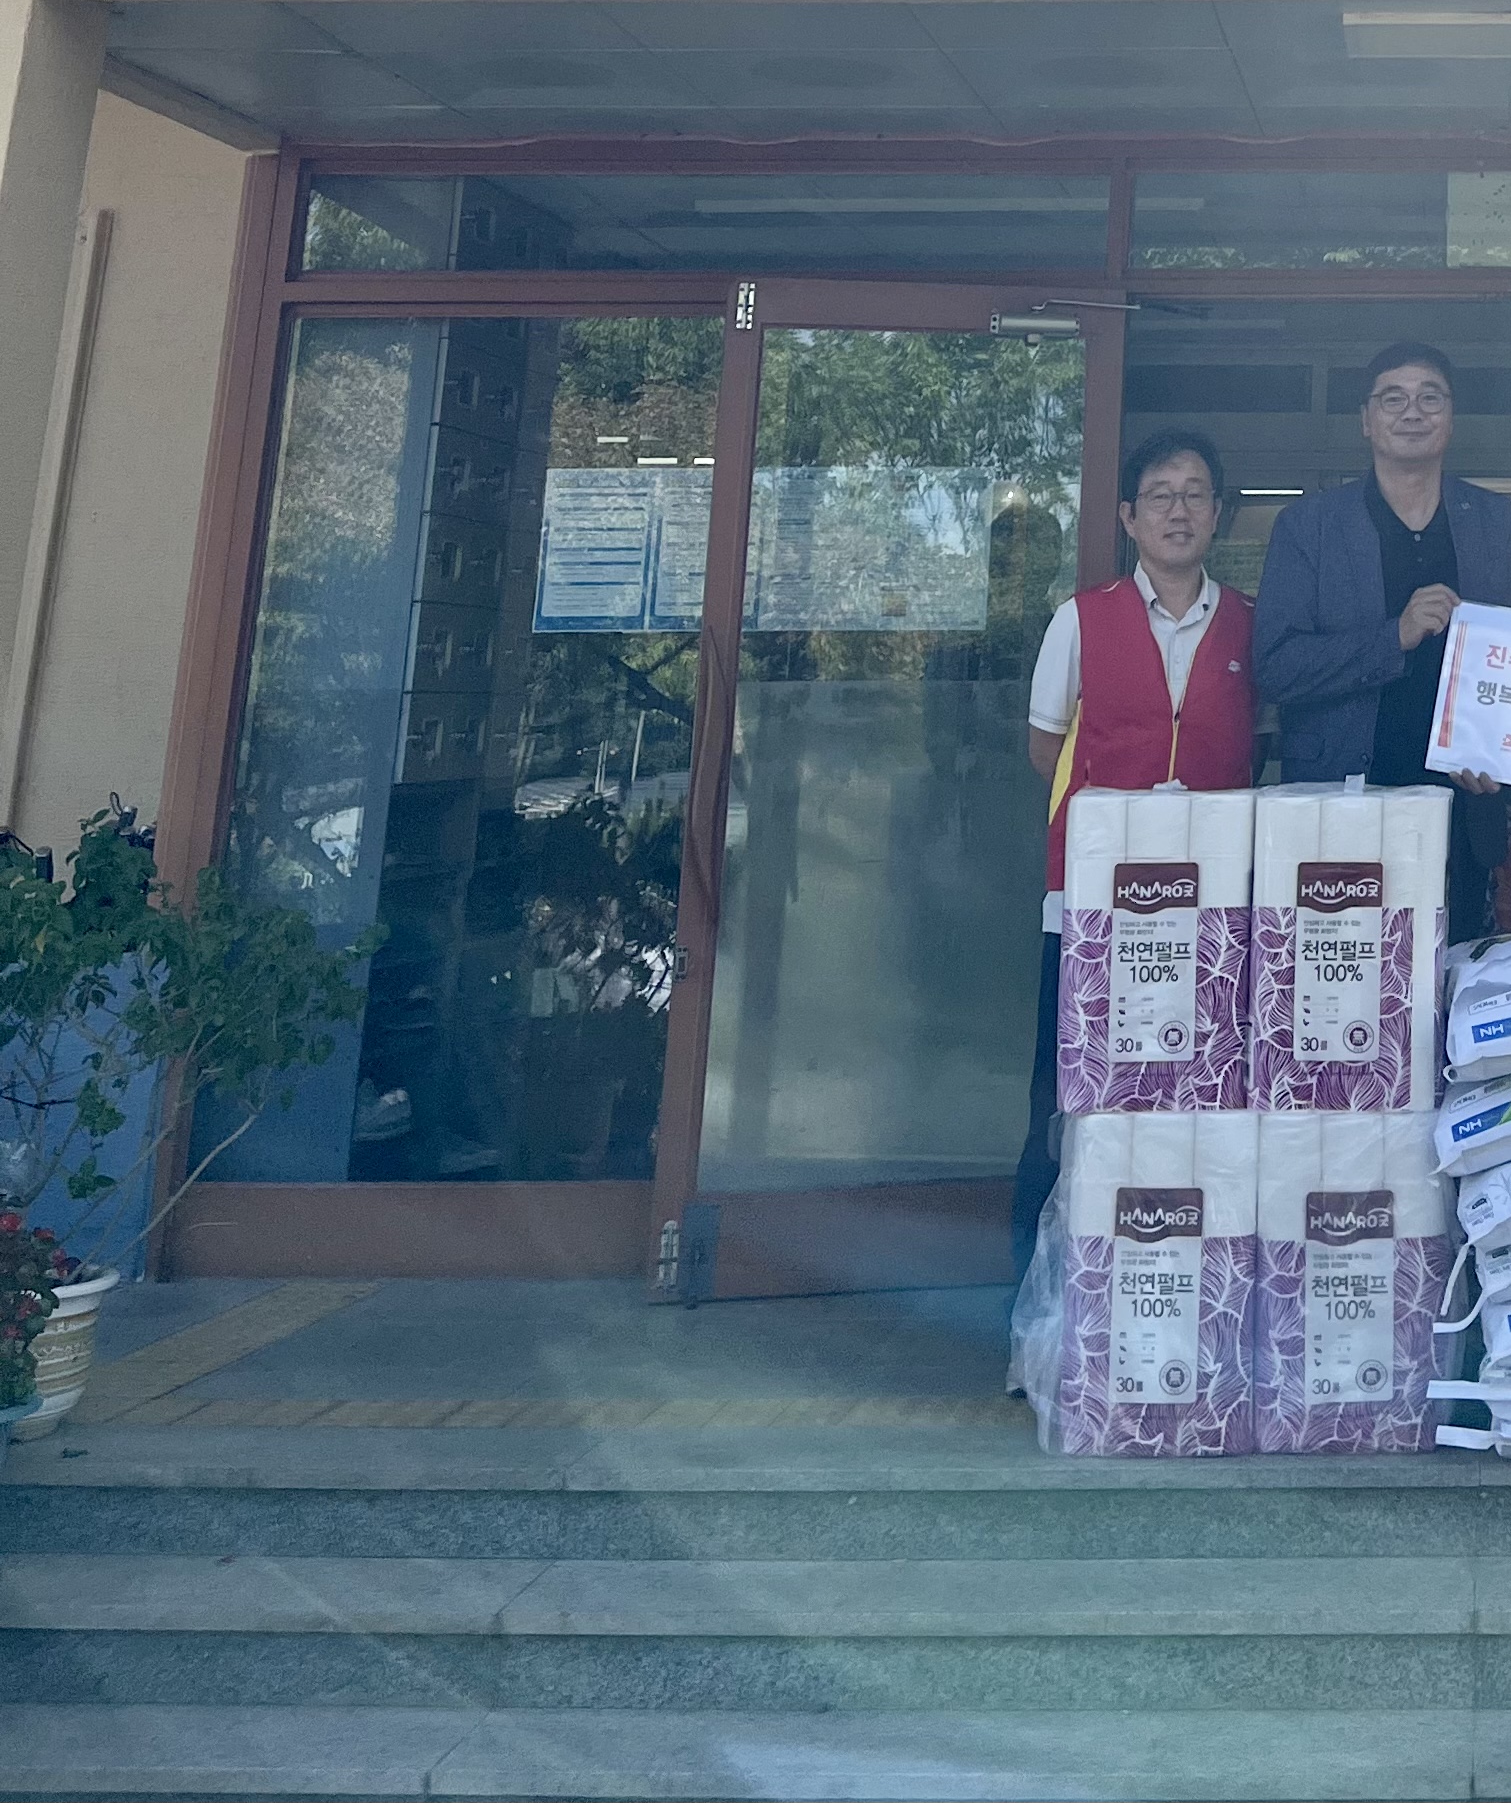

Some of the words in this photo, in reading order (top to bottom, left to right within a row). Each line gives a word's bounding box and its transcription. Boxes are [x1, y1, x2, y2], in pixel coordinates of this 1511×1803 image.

[1117, 941, 1192, 963] 천연펄프
[1301, 940, 1376, 962] 천연펄프
[1129, 964, 1179, 983] 100%
[1314, 963, 1364, 982] 100%
[1480, 1023, 1505, 1038] NH
[1458, 1118, 1482, 1135] NH
[1118, 1272, 1195, 1296] 천연펄프
[1311, 1275, 1389, 1298] 천연펄프
[1131, 1298, 1182, 1318] 100%
[1325, 1299, 1376, 1321] 100%
